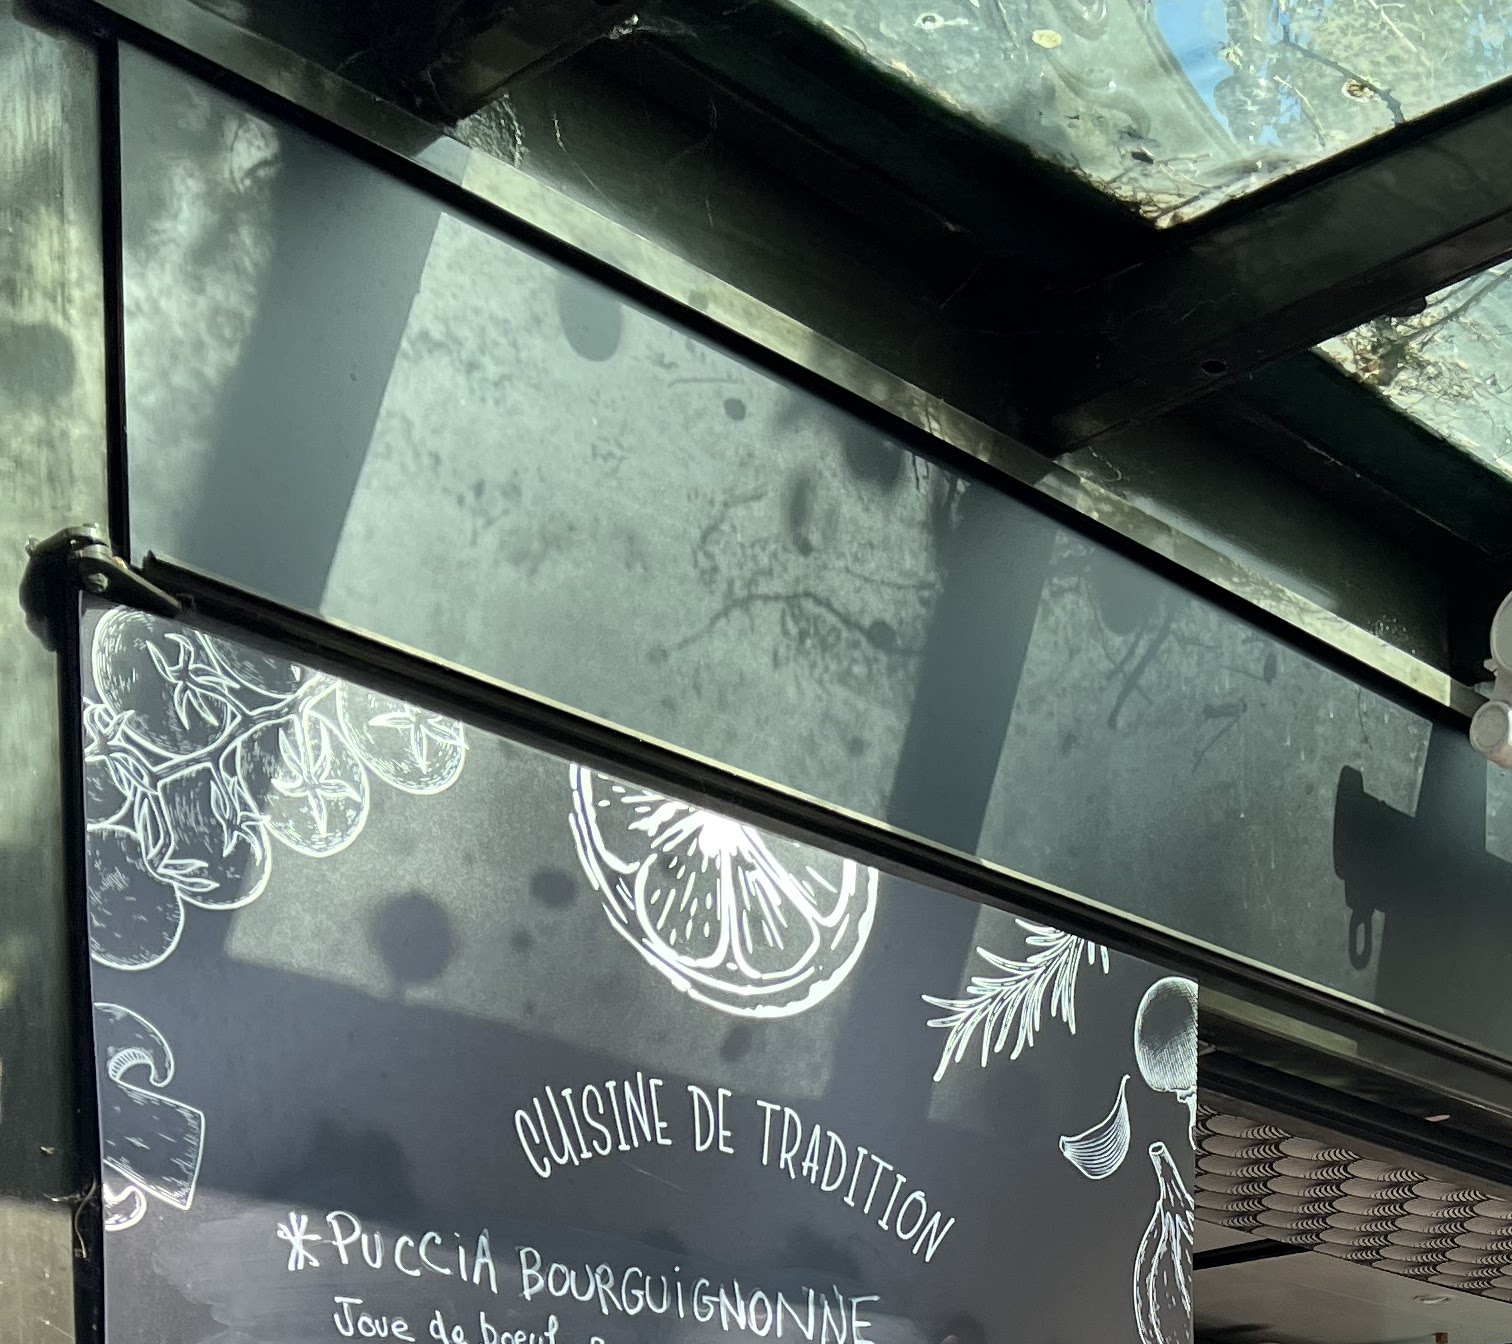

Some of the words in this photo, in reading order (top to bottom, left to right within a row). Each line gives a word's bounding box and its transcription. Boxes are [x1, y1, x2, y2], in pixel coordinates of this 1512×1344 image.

[514, 1071, 672, 1178] CUISINE
[687, 1084, 735, 1154] DE
[756, 1100, 956, 1263] TRADITION
[333, 1296, 416, 1342] Joue
